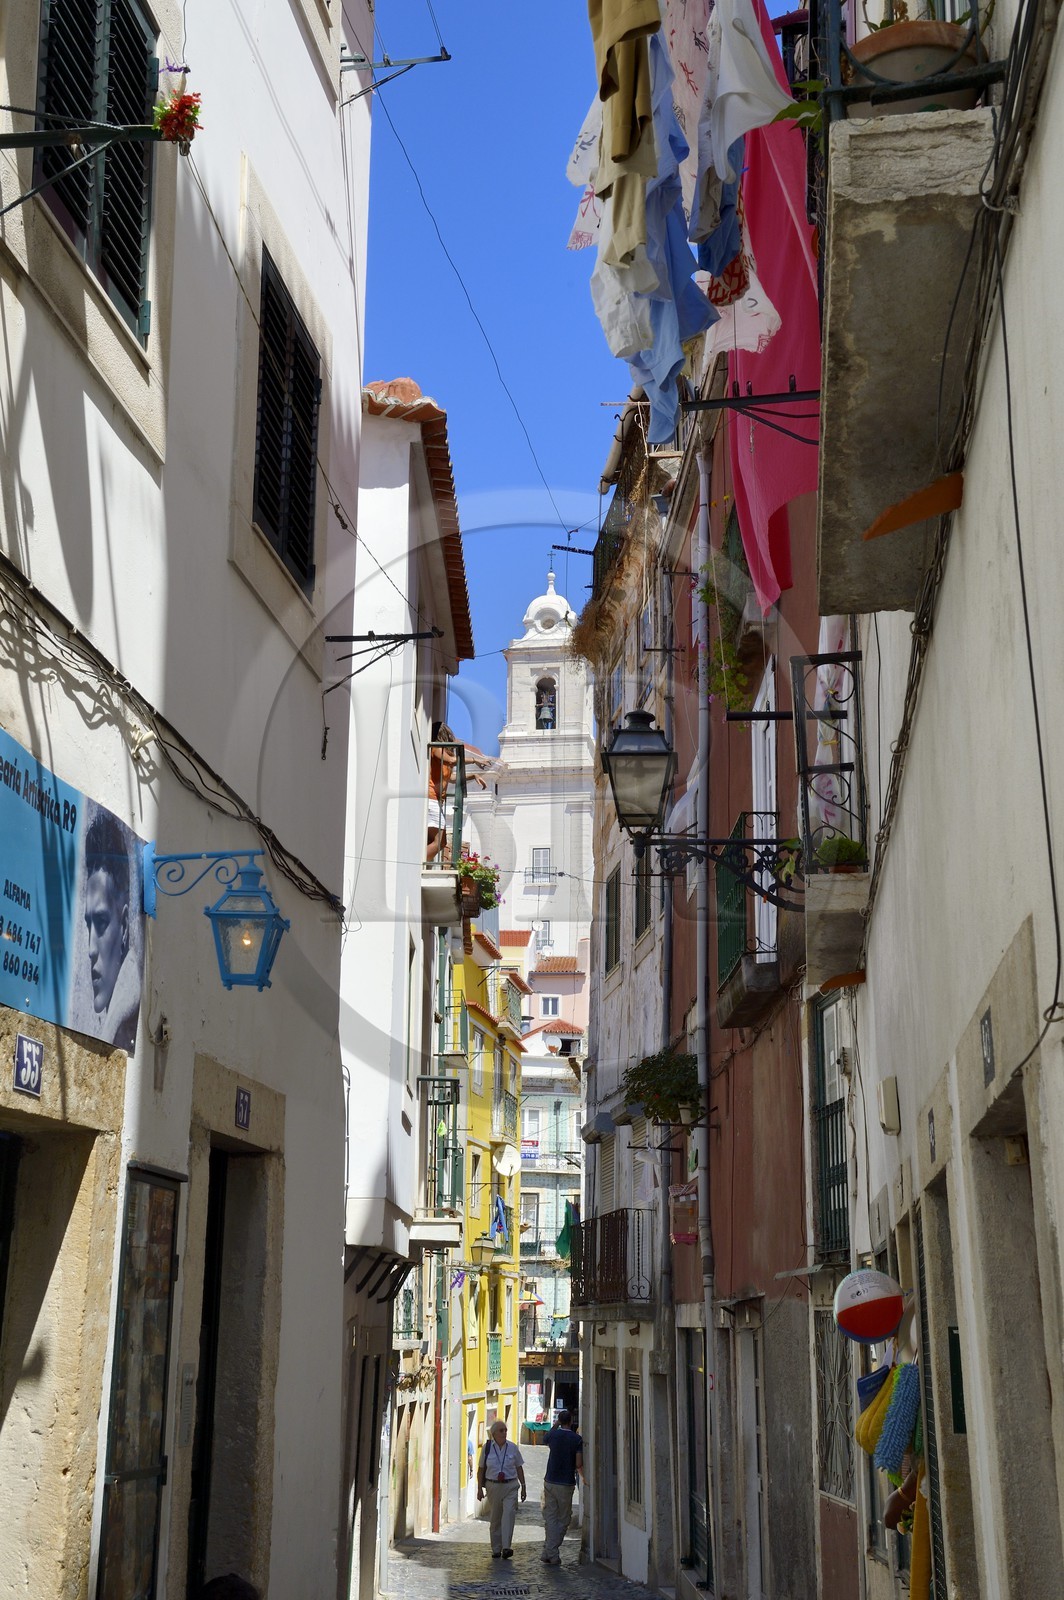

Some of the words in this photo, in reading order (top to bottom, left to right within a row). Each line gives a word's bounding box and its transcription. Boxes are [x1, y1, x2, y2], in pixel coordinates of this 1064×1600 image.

[61, 799, 77, 834] R9
[3, 879, 31, 911] ALFAMA
[3, 951, 20, 976] 860
[22, 960, 39, 985] 034
[21, 1040, 40, 1089] 55
